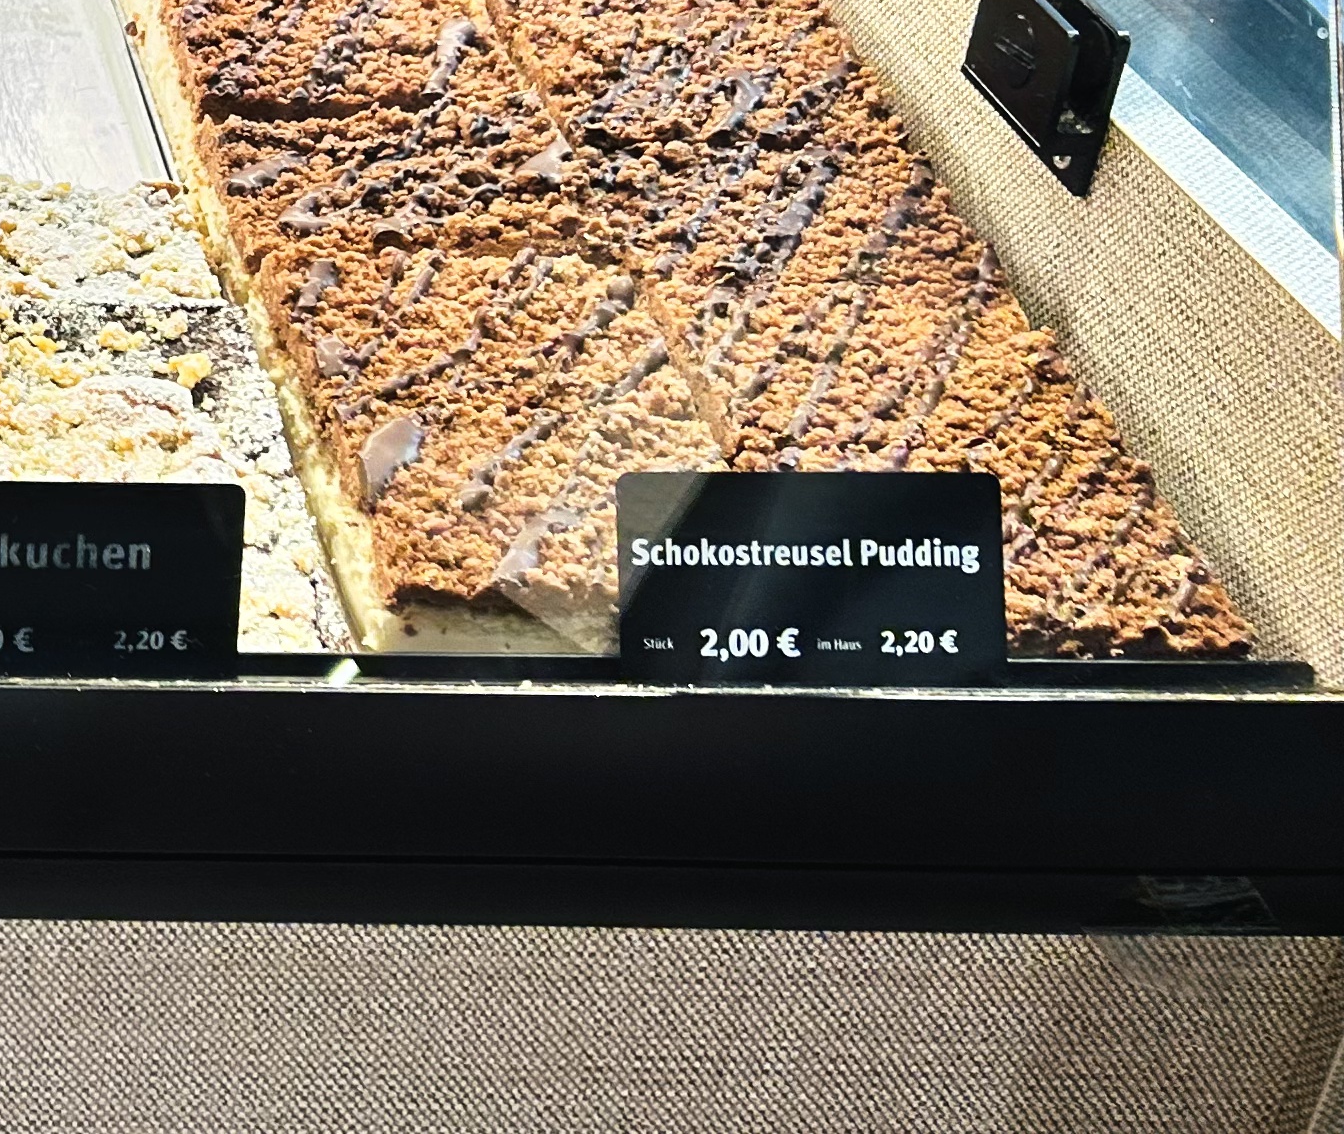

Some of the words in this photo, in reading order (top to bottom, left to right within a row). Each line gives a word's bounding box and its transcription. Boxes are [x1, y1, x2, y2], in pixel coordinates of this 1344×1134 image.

[631, 538, 853, 567] Schokostreusel
[861, 538, 981, 574] Pudding
[13, 626, 35, 653] €
[113, 629, 164, 654] 2,20
[169, 629, 189, 652] €
[643, 637, 674, 650] Stück
[699, 628, 769, 662] 2,00
[776, 627, 801, 658] €
[817, 638, 831, 651] im
[834, 638, 862, 651] Haus
[880, 630, 934, 657] 2,20
[940, 629, 959, 654] €
